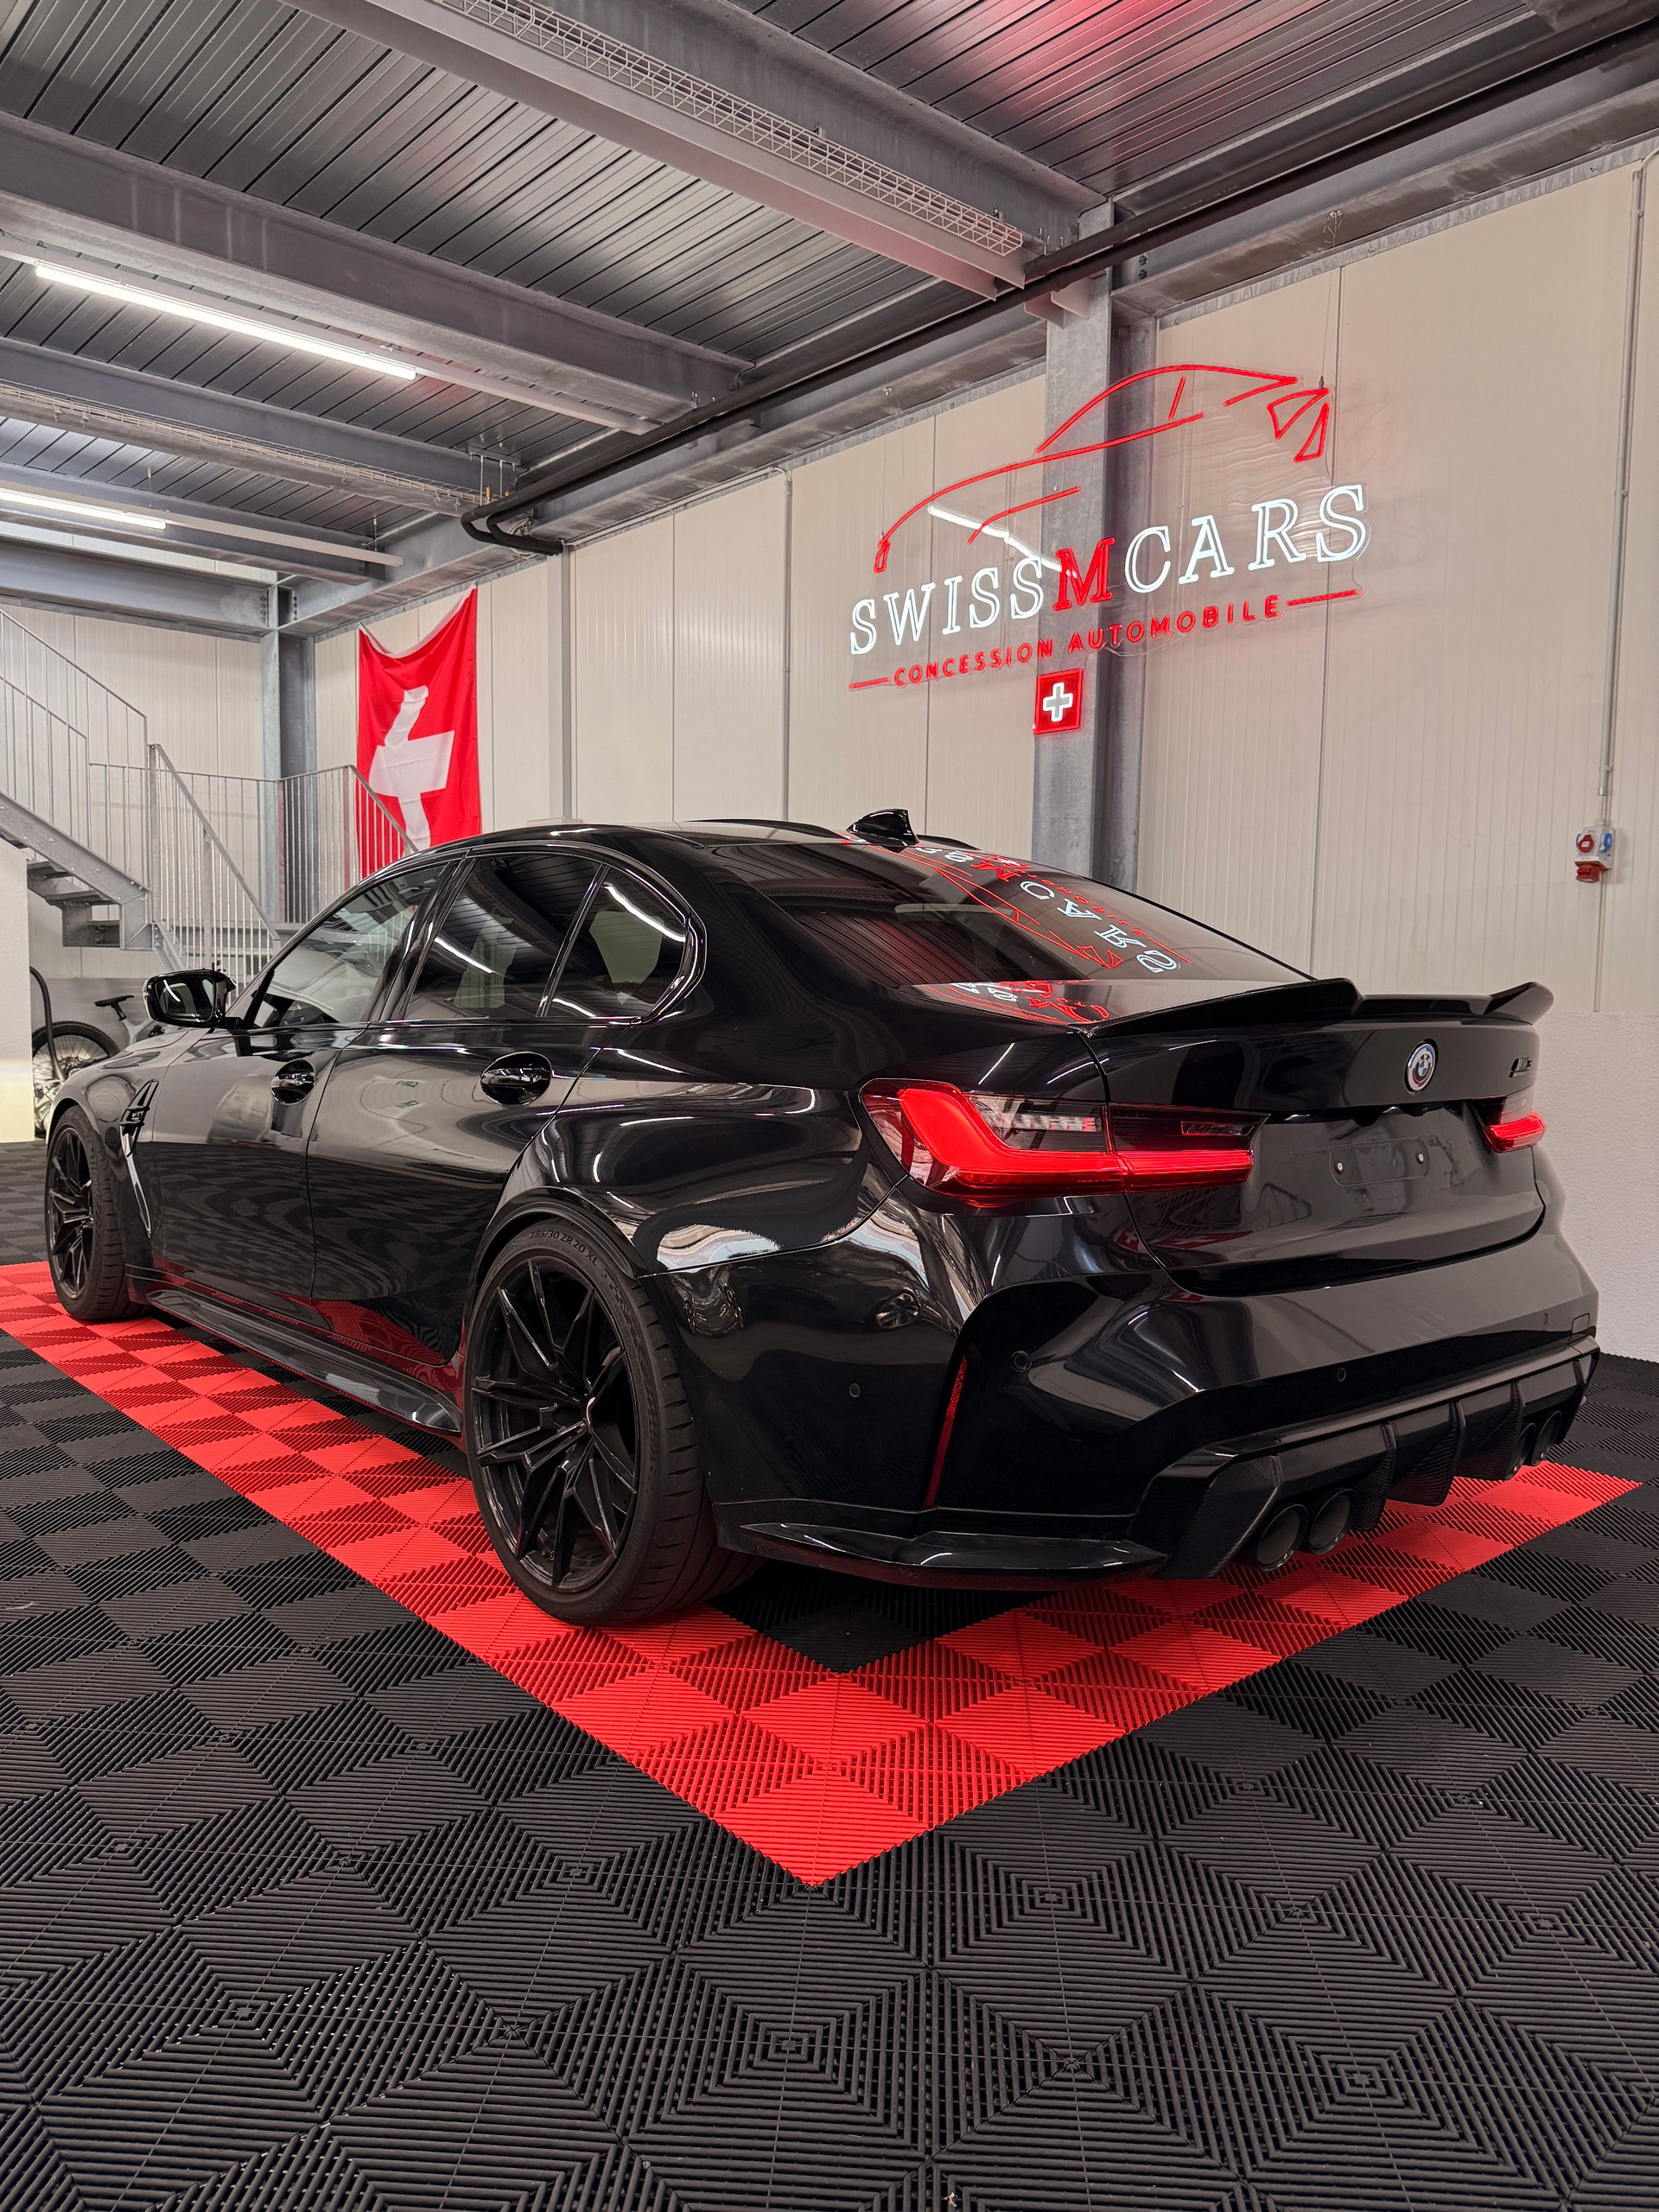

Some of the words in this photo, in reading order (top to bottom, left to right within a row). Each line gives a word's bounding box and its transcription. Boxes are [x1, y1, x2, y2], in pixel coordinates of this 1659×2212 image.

[893, 638, 1053, 687] CONCESSION
[1068, 594, 1281, 654] AUTOMOBILE
[530, 1229, 560, 1240] 285/30
[560, 1233, 574, 1245] ZR
[572, 1239, 586, 1253] 20
[585, 1249, 600, 1267] XL
